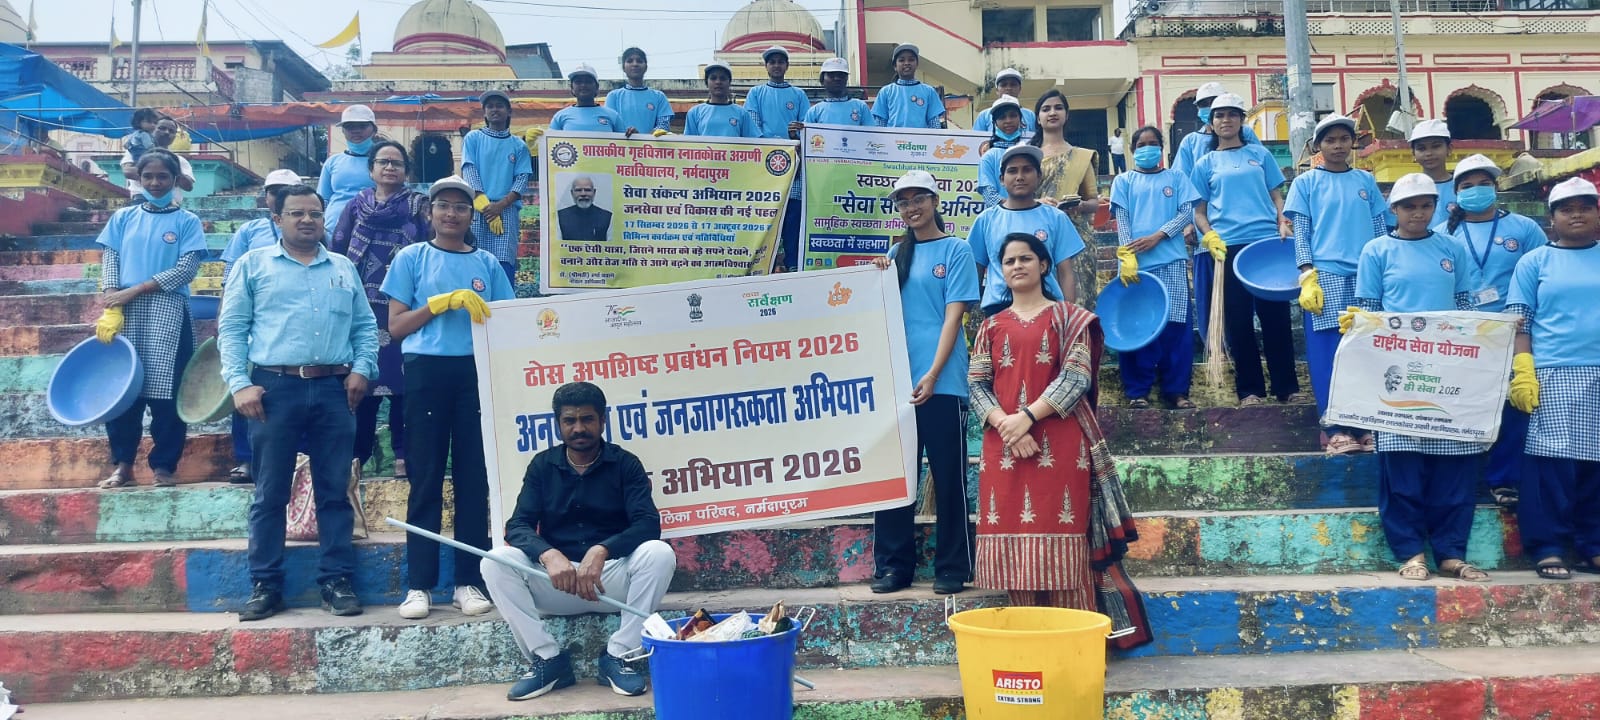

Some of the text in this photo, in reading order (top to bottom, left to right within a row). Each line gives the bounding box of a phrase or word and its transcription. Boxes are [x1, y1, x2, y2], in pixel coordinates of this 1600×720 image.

[582, 143, 625, 157] शासकीय
[629, 144, 674, 161] गृहविज्ञान
[730, 148, 762, 162] अग्रणी
[616, 163, 729, 183] महाविद्यालय, नर्मदापुरम
[623, 184, 781, 201] सेवा संकल्प अभियान 2026
[955, 180, 978, 192] 202
[624, 202, 778, 218] जनसेवा एवं विकास की नई पहल
[691, 220, 698, 229] से
[814, 216, 848, 232] सामूहिक
[851, 219, 882, 229] स्वच्छता
[623, 231, 649, 240] विभिन्न
[682, 232, 694, 241] एवं
[810, 236, 888, 250] स्वच्छता में सहभाग
[585, 244, 601, 253] ऐसी
[629, 244, 654, 254] जिसने
[679, 245, 689, 255] को
[705, 246, 724, 255] सपने
[586, 256, 602, 266] और
[604, 257, 619, 266] तेज
[622, 257, 638, 266] गति
[640, 257, 648, 266] से
[650, 257, 669, 267] आगे
[691, 259, 701, 267] का
[746, 293, 792, 307] सर्वेक्षण
[760, 307, 777, 317] 2026
[1373, 334, 1480, 359] राष्ट्रीय सेवा योजना
[523, 332, 859, 387] ठोस अपशिष्ट प्रबंधन नियम 2026
[1406, 373, 1441, 384] स्वच्छता
[1403, 382, 1461, 396] ही सेवा 2026
[616, 389, 648, 441] एवं
[793, 372, 875, 421] अभियान
[662, 457, 774, 495] अभियान
[782, 446, 862, 482] 2026
[696, 505, 739, 520] परिषद,
[744, 497, 808, 516] नर्मदापुरम
[996, 678, 1041, 689] ARISTO
[997, 695, 1015, 703] EXTRA
